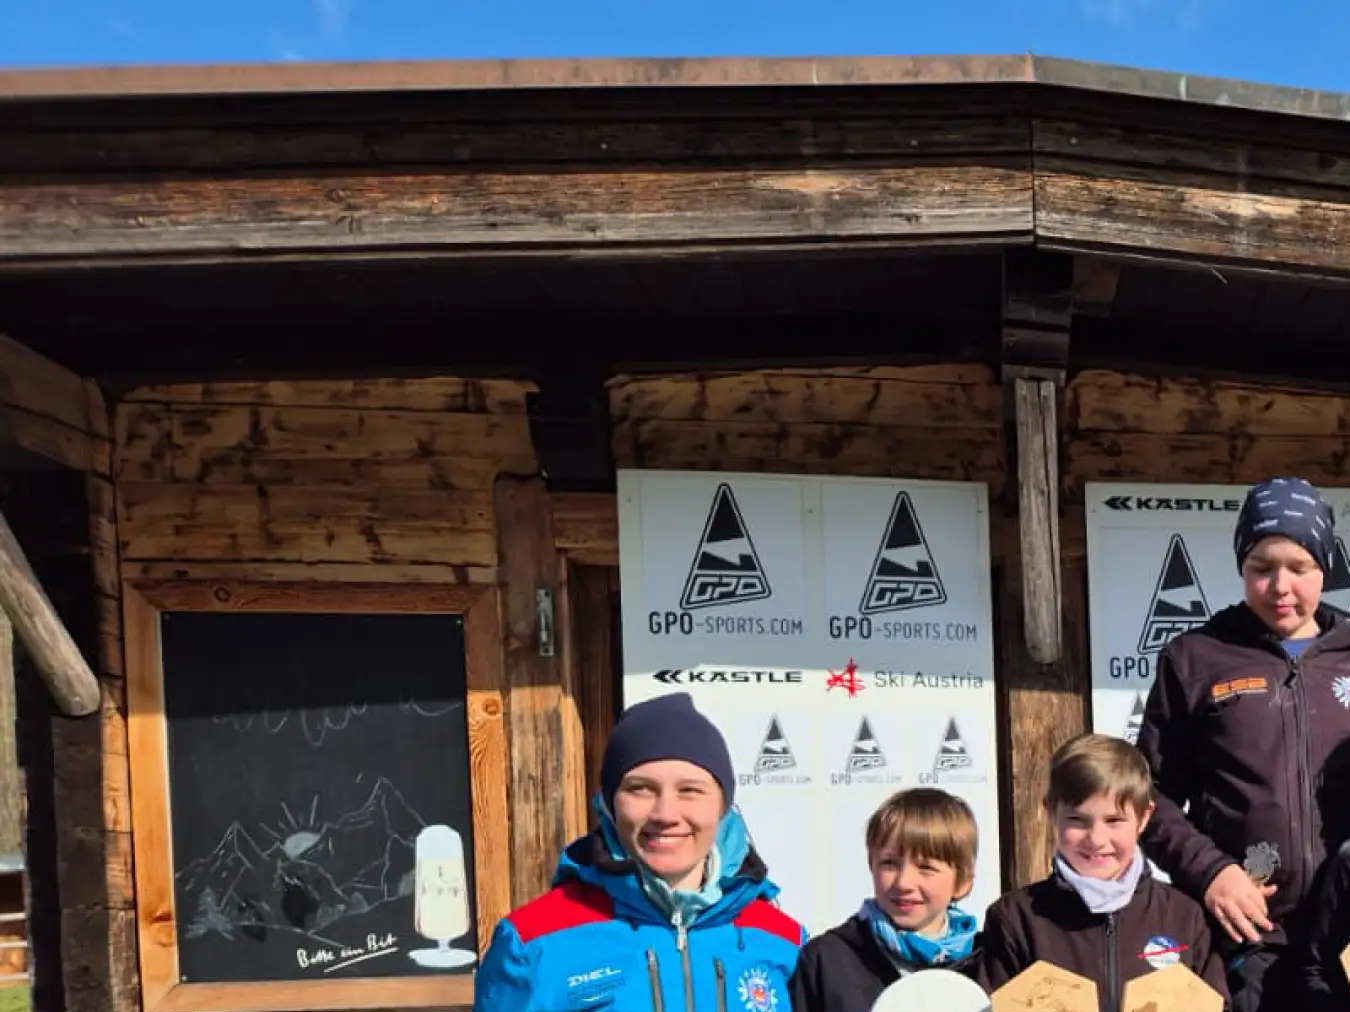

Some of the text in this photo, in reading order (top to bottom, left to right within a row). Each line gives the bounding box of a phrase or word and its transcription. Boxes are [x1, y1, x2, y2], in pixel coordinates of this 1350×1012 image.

[648, 611, 803, 635] GPO-SPORTS.COM
[829, 616, 978, 642] GPO-SPORTS.COM
[873, 669, 983, 688] Ski Austria
